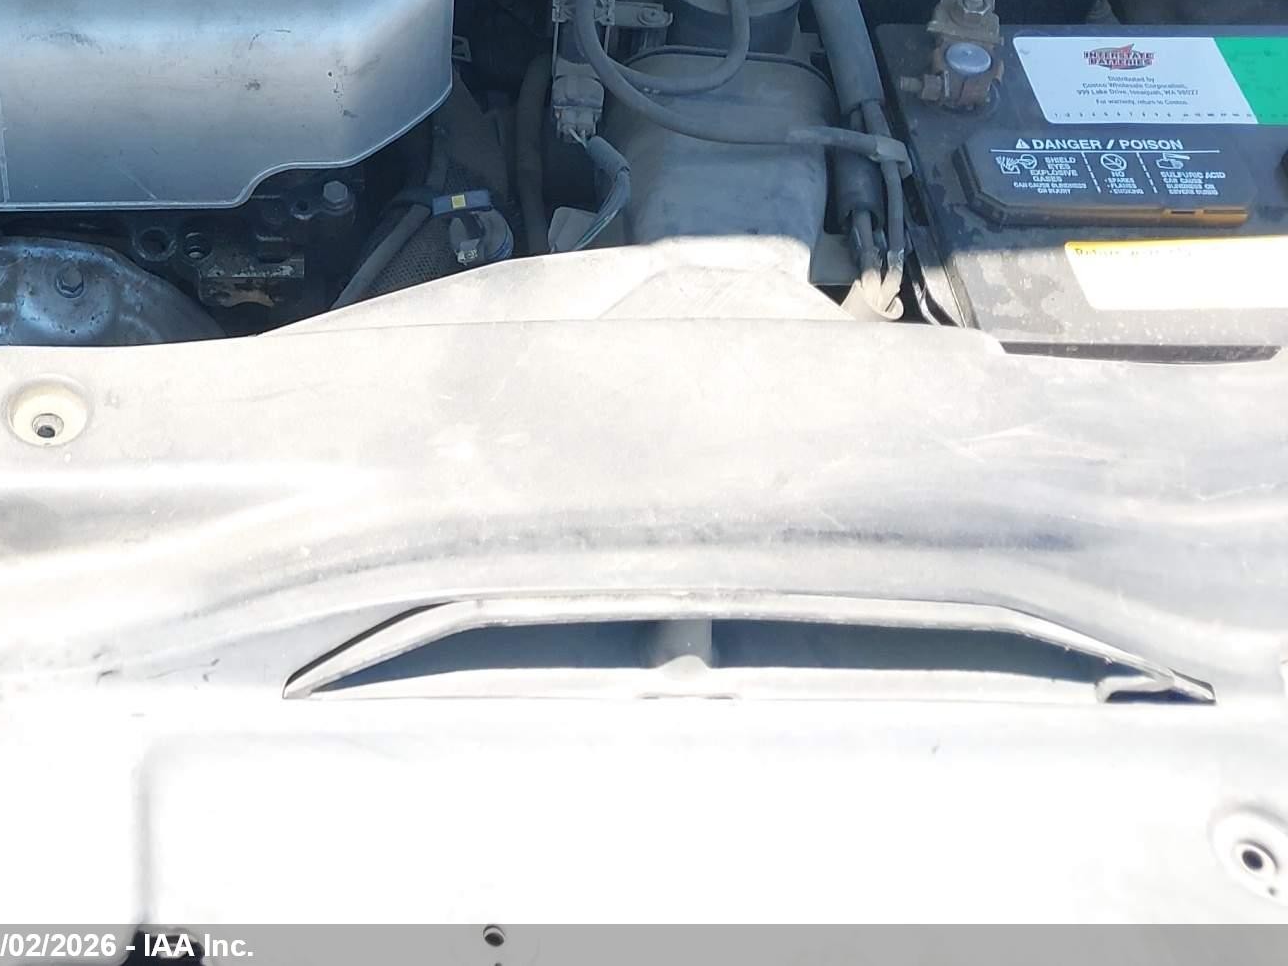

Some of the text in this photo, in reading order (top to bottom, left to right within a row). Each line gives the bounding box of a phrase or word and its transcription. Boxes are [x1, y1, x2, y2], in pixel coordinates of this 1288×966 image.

[1083, 50, 1154, 59] INTERSTATE
[1088, 58, 1152, 66] BATTERIES
[1032, 138, 1102, 150] DANGER
[1118, 139, 1184, 150] POISON
[1044, 156, 1076, 164] SHIELD
[1030, 169, 1079, 177] EXPLOSIVE
[1160, 171, 1226, 179] SULFURIC ACID
